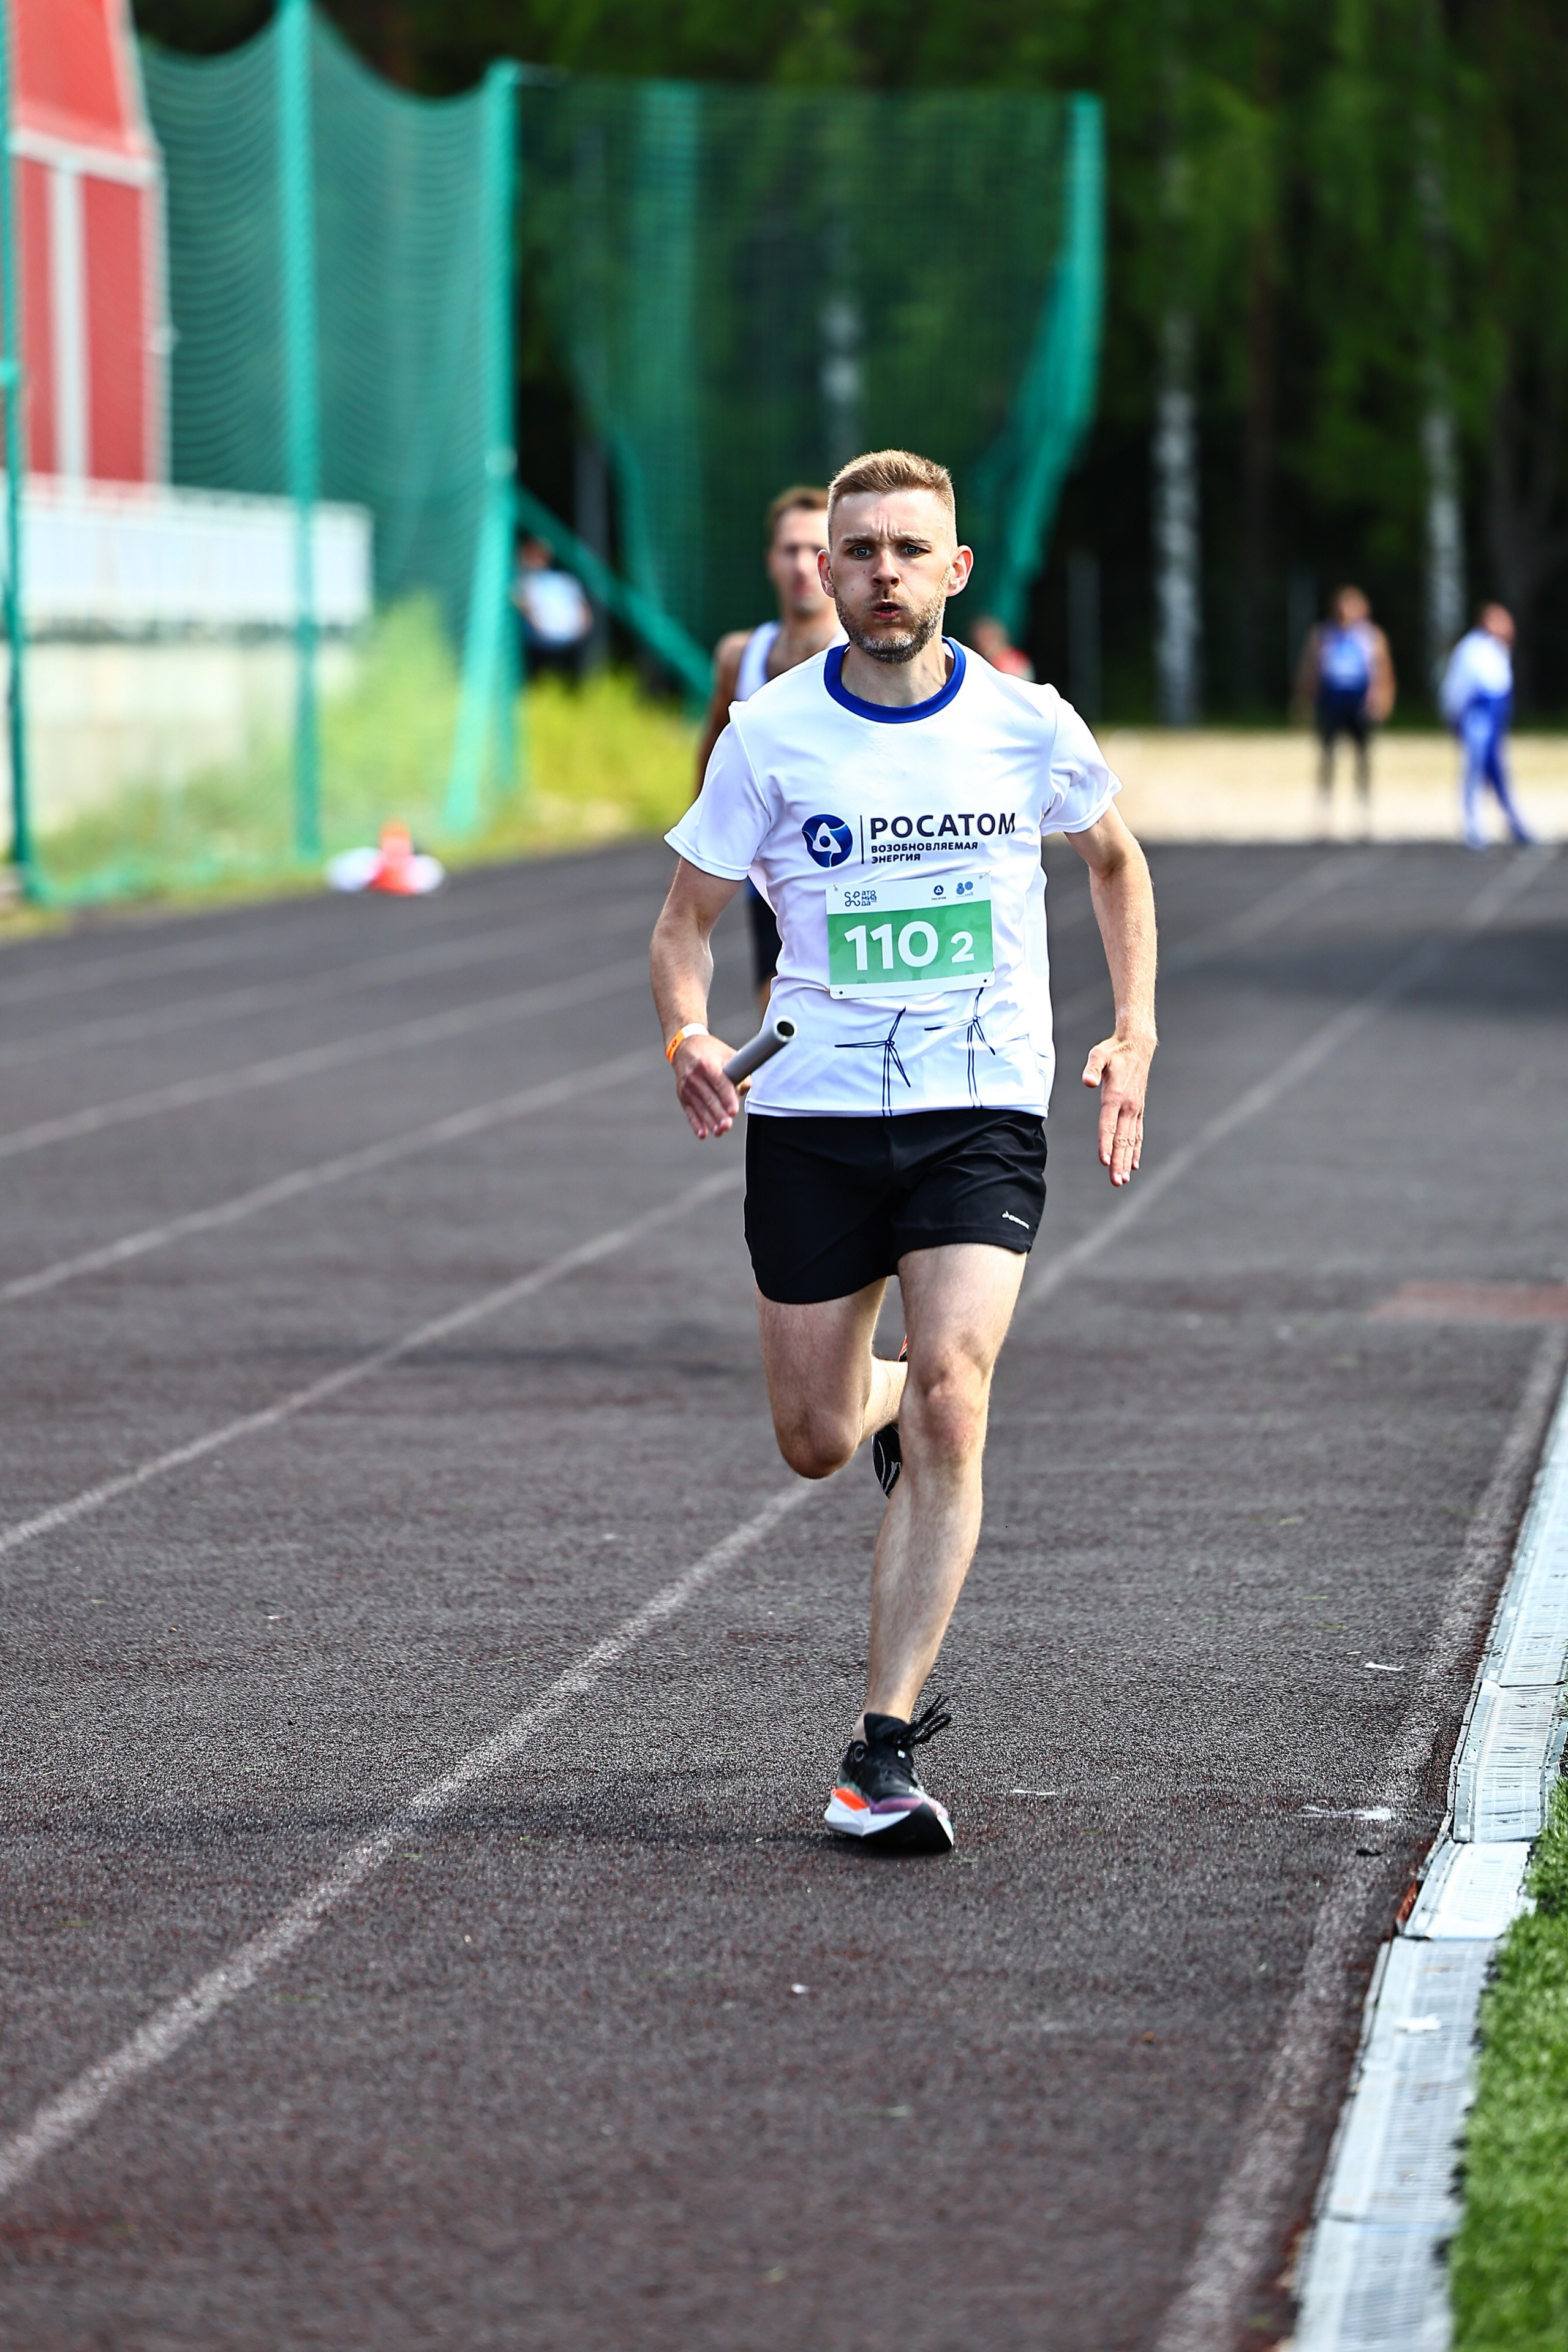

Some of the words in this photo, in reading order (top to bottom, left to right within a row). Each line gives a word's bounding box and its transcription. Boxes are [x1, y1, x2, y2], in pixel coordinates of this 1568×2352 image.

[870, 812, 1016, 840] РОСАТОМ
[871, 842, 978, 853] ВОЗОБНОВЛЯЕМАЯ
[871, 853, 921, 864] ЭНЕРГИЯ
[844, 921, 938, 971] 110
[950, 931, 974, 963] 2
